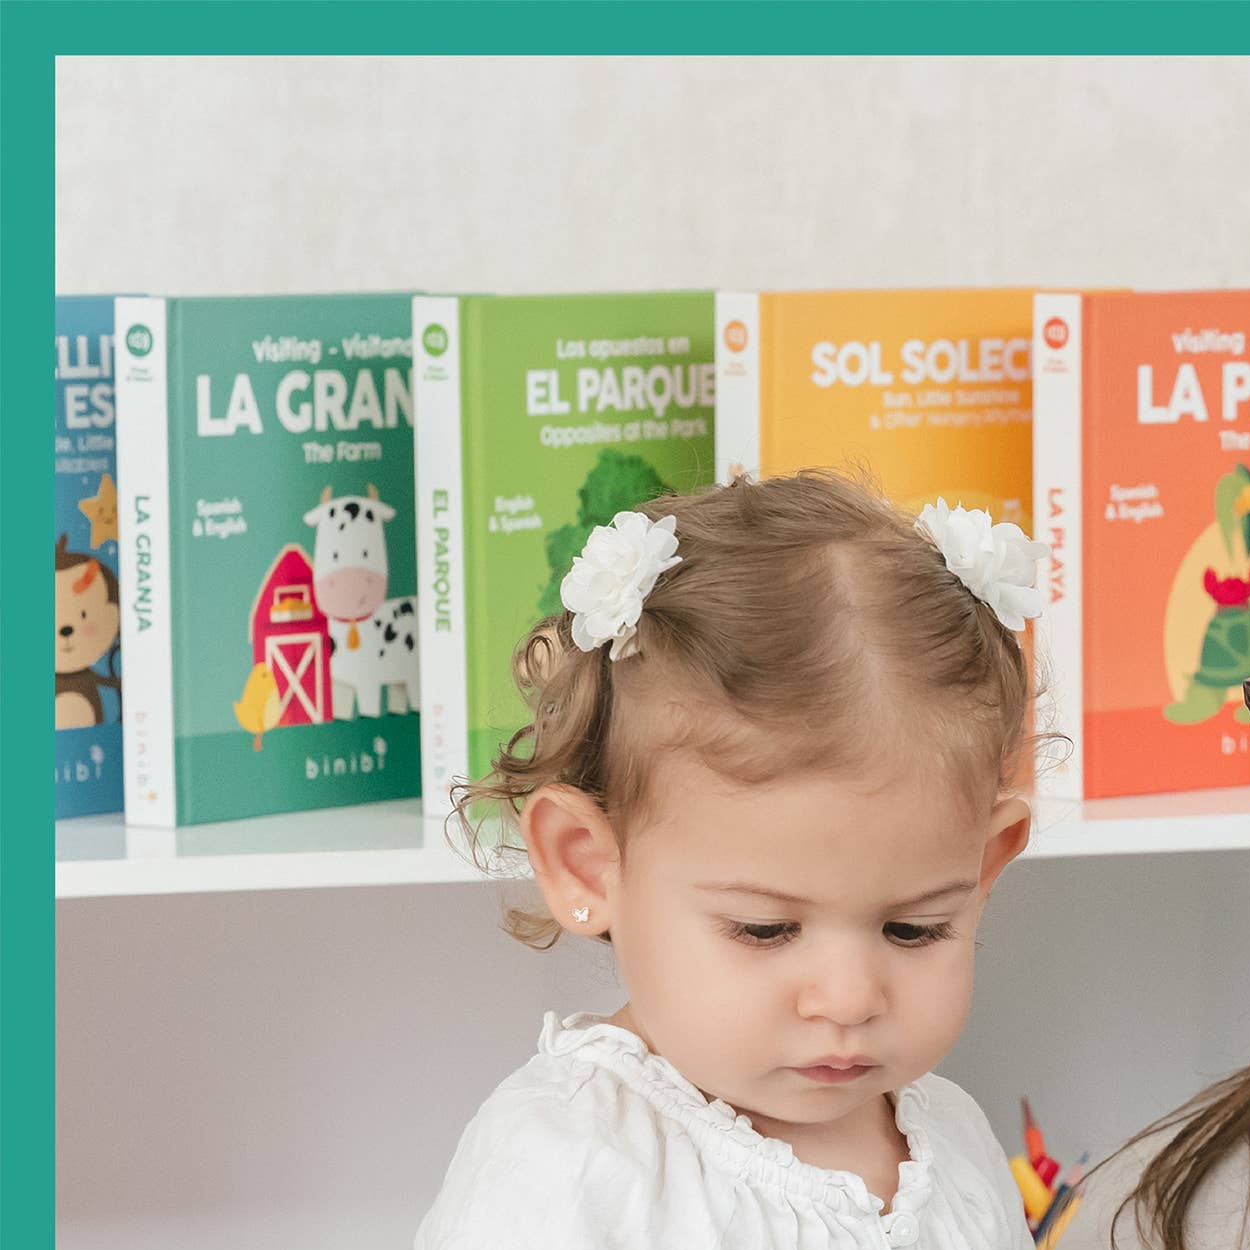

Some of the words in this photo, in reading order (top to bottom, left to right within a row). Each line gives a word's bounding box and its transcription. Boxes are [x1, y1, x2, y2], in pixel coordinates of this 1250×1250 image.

[526, 368, 570, 416] EL
[576, 362, 716, 418] PARQUE
[811, 339, 894, 388] SOL
[900, 337, 1033, 385] SOLEC
[196, 373, 263, 436] LA
[275, 367, 414, 433] GRAN
[1136, 362, 1209, 424] LA
[134, 496, 150, 525] LA
[432, 489, 449, 518] EL
[1048, 488, 1064, 518] LA
[433, 526, 451, 633] PARQUE
[1049, 527, 1066, 604] PLAYA
